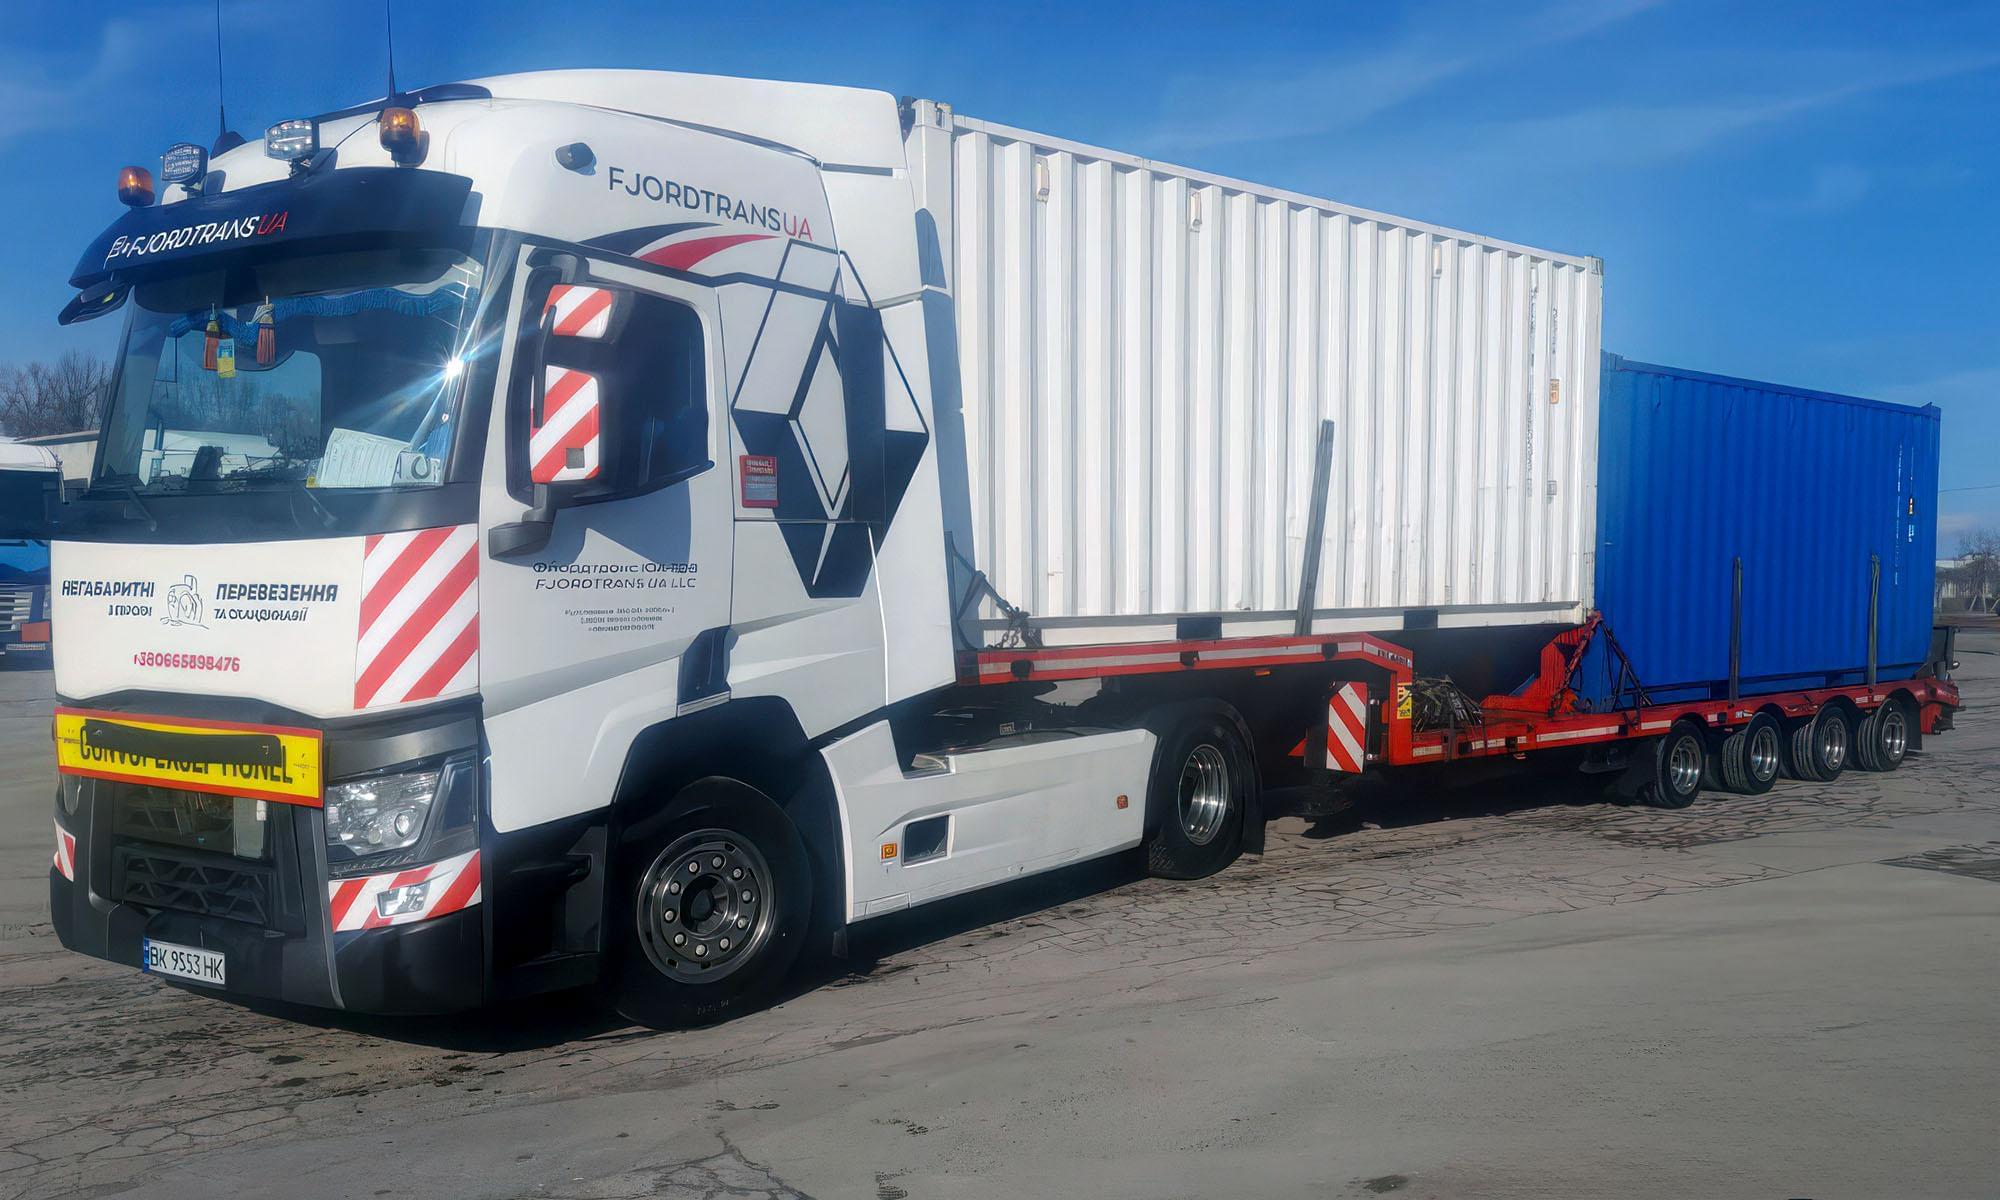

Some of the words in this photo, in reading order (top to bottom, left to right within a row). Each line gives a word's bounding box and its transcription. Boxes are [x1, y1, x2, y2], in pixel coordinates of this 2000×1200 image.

[62, 580, 155, 597] НЕГАБАРИТНІ
[216, 583, 338, 601] ПЕРЕВЕЗЕННЯ
[150, 947, 167, 969] BK
[171, 951, 200, 975] 9553
[203, 956, 223, 980] HK
